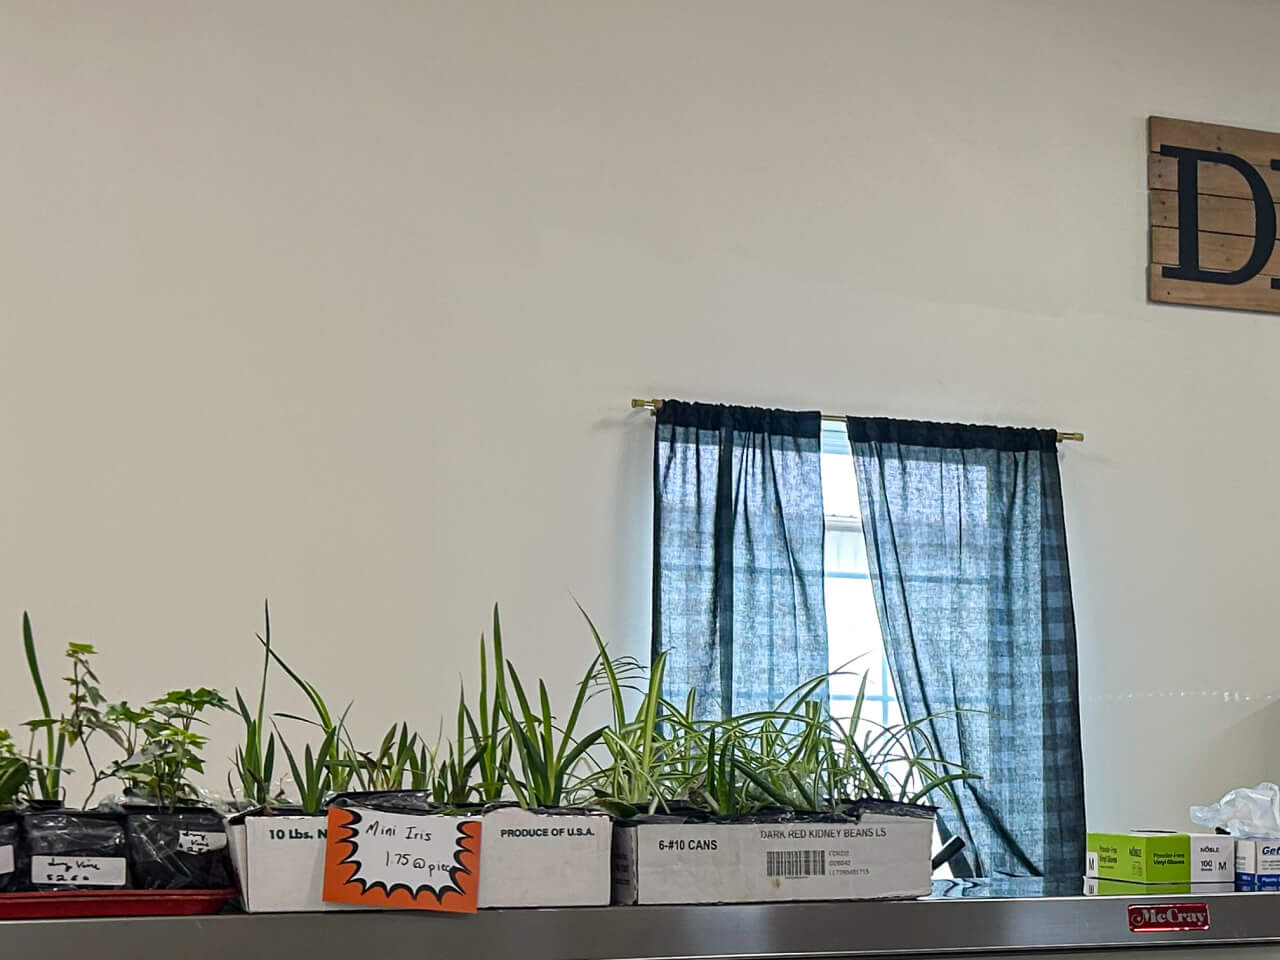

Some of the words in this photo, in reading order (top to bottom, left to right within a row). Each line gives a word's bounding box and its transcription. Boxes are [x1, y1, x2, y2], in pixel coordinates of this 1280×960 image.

[269, 829, 284, 839] 10
[288, 829, 313, 839] Lbs.
[317, 830, 327, 839] N
[365, 820, 397, 837] Mini
[405, 826, 432, 842] Iris
[500, 829, 549, 838] PRODUCE
[551, 828, 565, 837] OF
[567, 827, 595, 837] U.S.A.
[761, 830, 786, 839] DARK
[788, 829, 807, 839] RED
[808, 829, 841, 839] KIDNEY
[843, 827, 874, 838] BEANS
[875, 827, 887, 838] LS
[658, 840, 685, 850] 6-#10
[688, 839, 718, 850] CANS
[1262, 846, 1280, 856] Get
[413, 858, 426, 870] @
[1088, 857, 1095, 871] M
[1218, 862, 1227, 871] M
[1130, 908, 1206, 926] McCray
